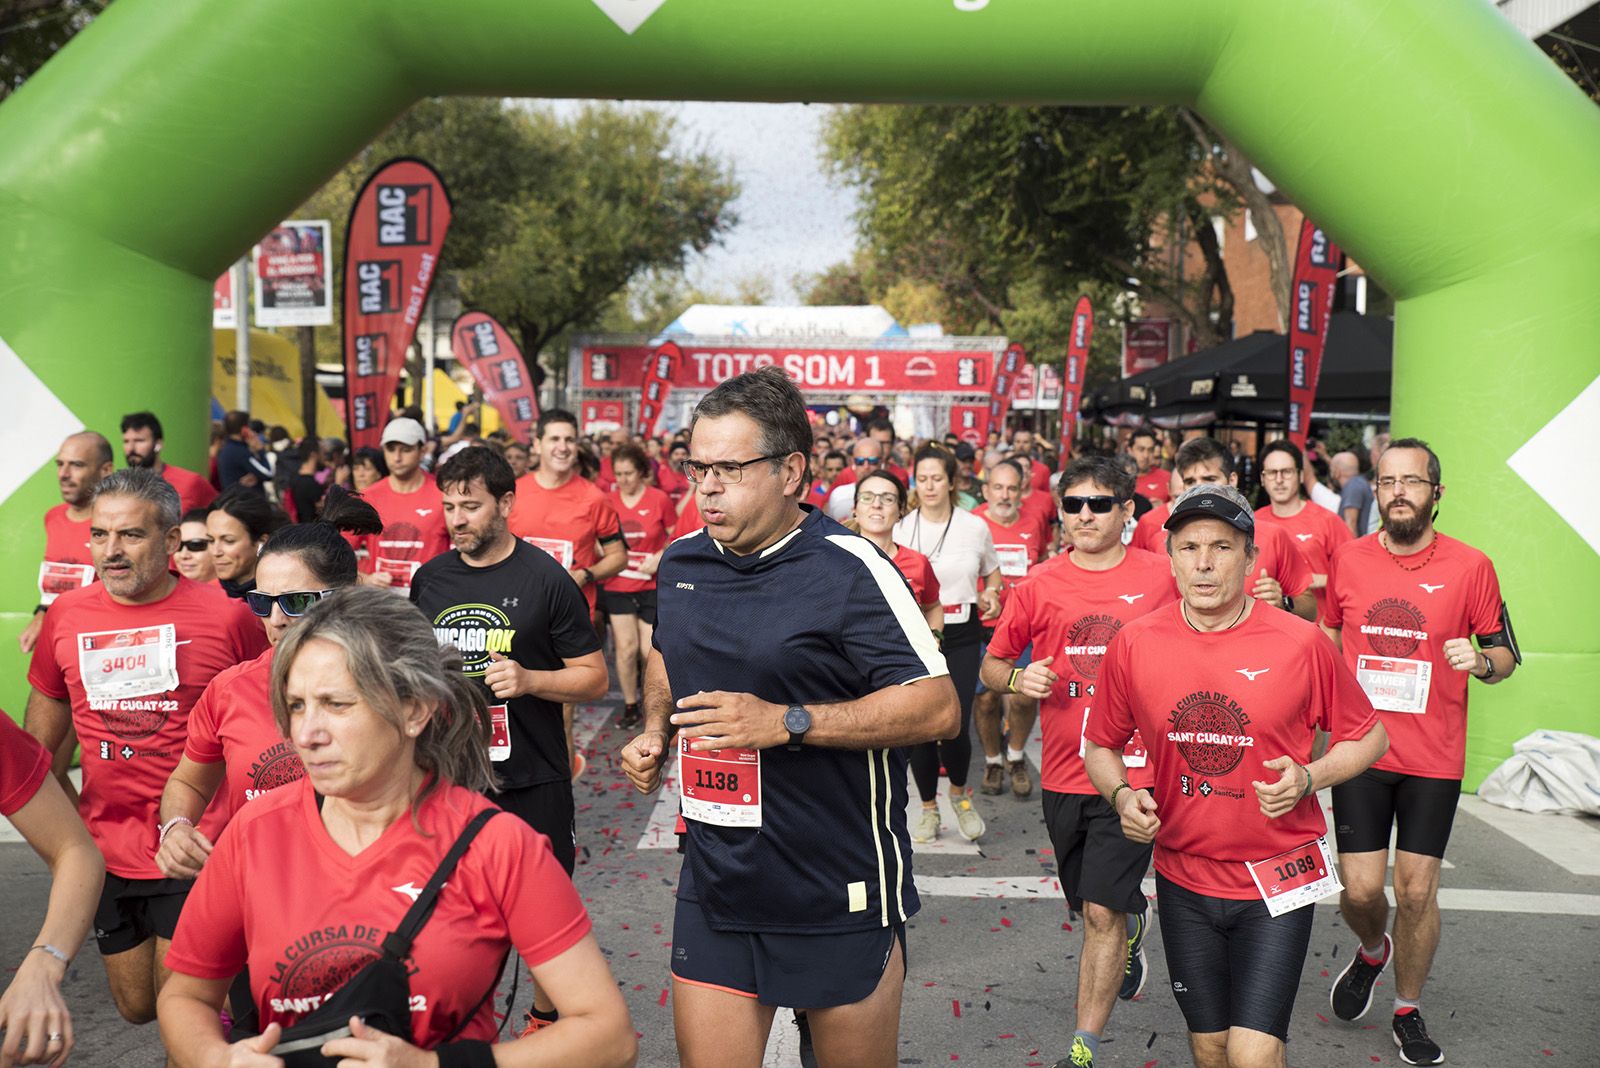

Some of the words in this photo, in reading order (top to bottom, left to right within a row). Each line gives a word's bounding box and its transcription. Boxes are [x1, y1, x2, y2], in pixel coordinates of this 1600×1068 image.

[784, 354, 855, 386] SOM
[864, 355, 886, 387] 1
[676, 582, 695, 591] KIPSTA
[440, 610, 467, 626] UNDER
[469, 609, 501, 626] ARMOUR
[1072, 615, 1100, 631] CURSA
[1360, 625, 1384, 634] SANT
[1384, 627, 1413, 638] CUGAT
[1064, 646, 1087, 655] SANT
[102, 654, 147, 673] 3404
[1368, 673, 1407, 687] XAVIER
[89, 700, 119, 711] SANT
[120, 701, 159, 711] CUGAT
[1167, 710, 1179, 723] LA
[1176, 691, 1211, 711] CURSA
[1213, 691, 1228, 704] DE
[1167, 732, 1195, 743] SANT
[1196, 733, 1234, 746] CUGAT
[246, 762, 261, 779] LA
[695, 769, 739, 792] 1138
[1274, 854, 1316, 882] 1089
[269, 961, 288, 984] LA
[285, 925, 348, 960] CURSA
[354, 925, 379, 942] DE
[270, 996, 321, 1013] SANT
